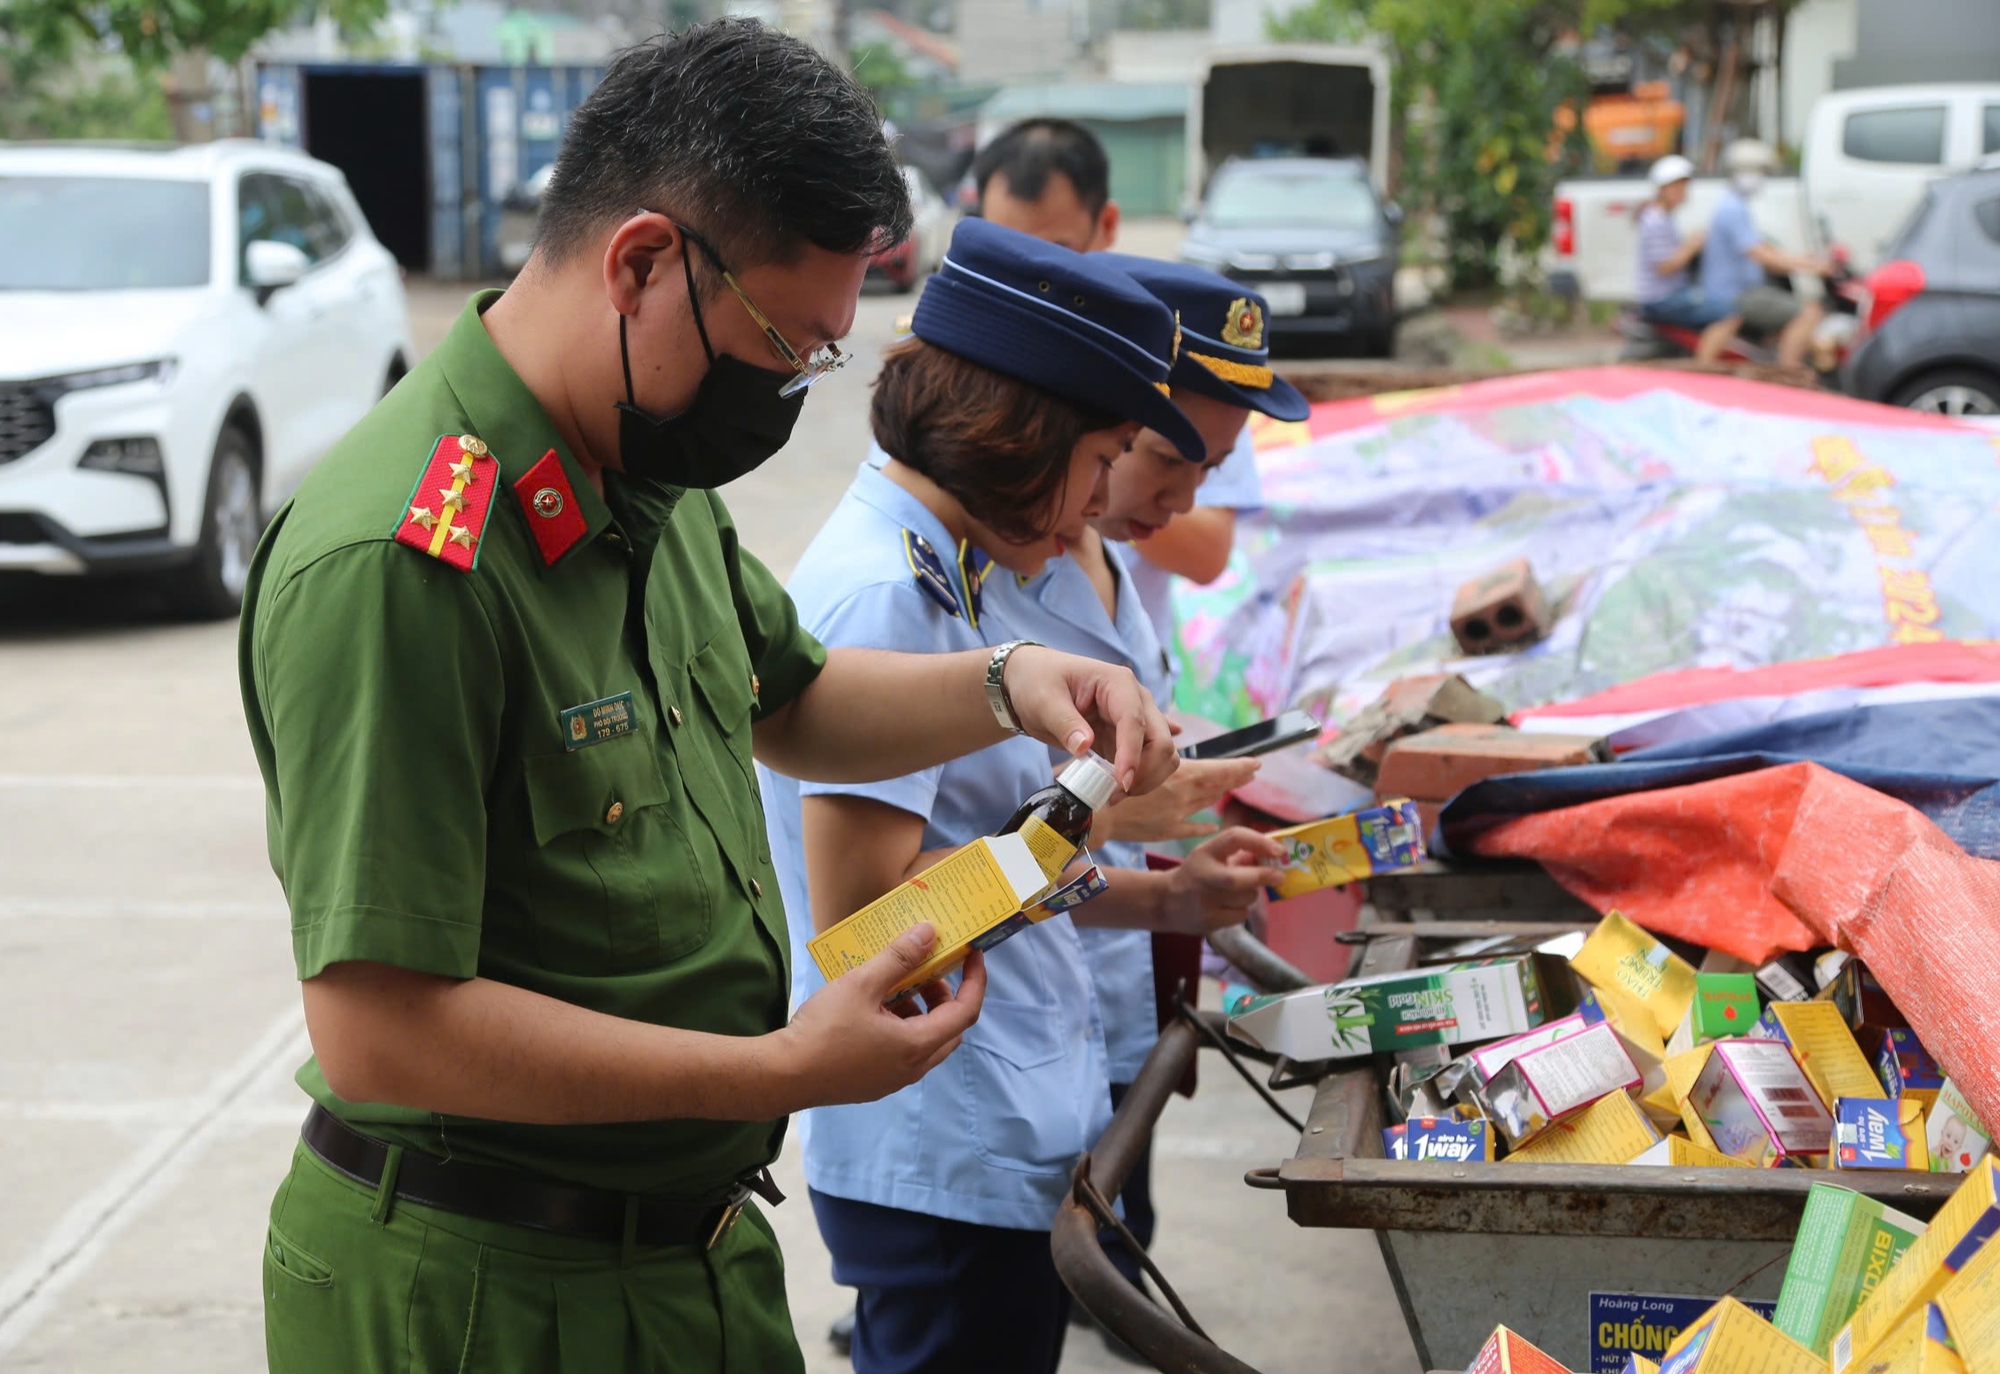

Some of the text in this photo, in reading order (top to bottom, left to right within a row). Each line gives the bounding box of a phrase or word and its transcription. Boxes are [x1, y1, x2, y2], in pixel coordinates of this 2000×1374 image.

[597, 728, 611, 738] 179
[1456, 1134, 1468, 1143] ho
[1860, 1106, 1893, 1162] 1way
[1414, 1133, 1477, 1162] 1way
[1642, 1299, 1674, 1313] Long
